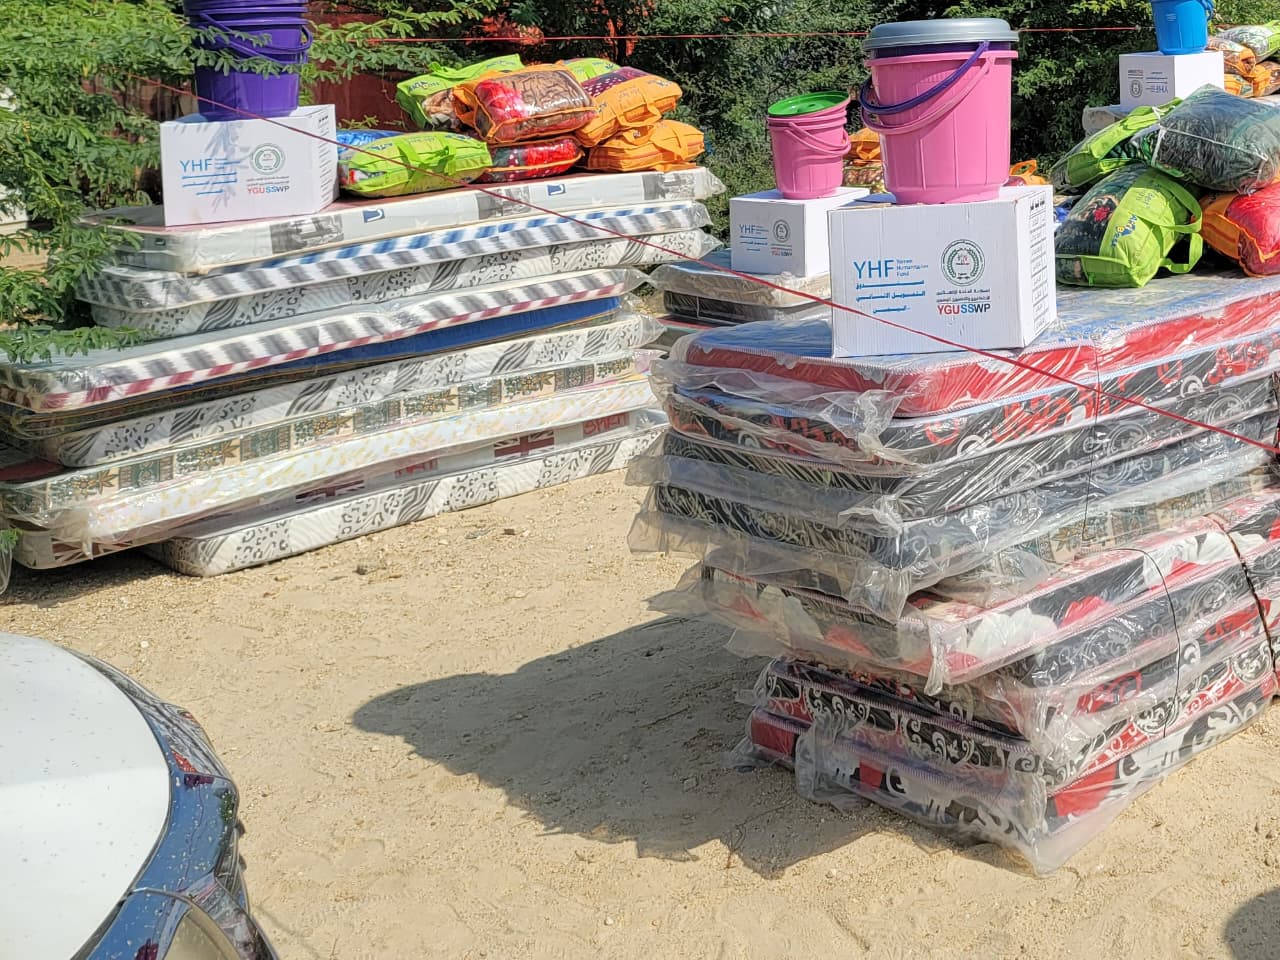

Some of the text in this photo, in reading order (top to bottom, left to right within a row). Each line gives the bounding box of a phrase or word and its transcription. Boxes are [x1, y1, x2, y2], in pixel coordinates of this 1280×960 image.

[180, 158, 212, 172] YHF
[739, 224, 756, 234] YHF
[853, 259, 894, 279] YHF
[937, 303, 991, 315] YGUSSWP
